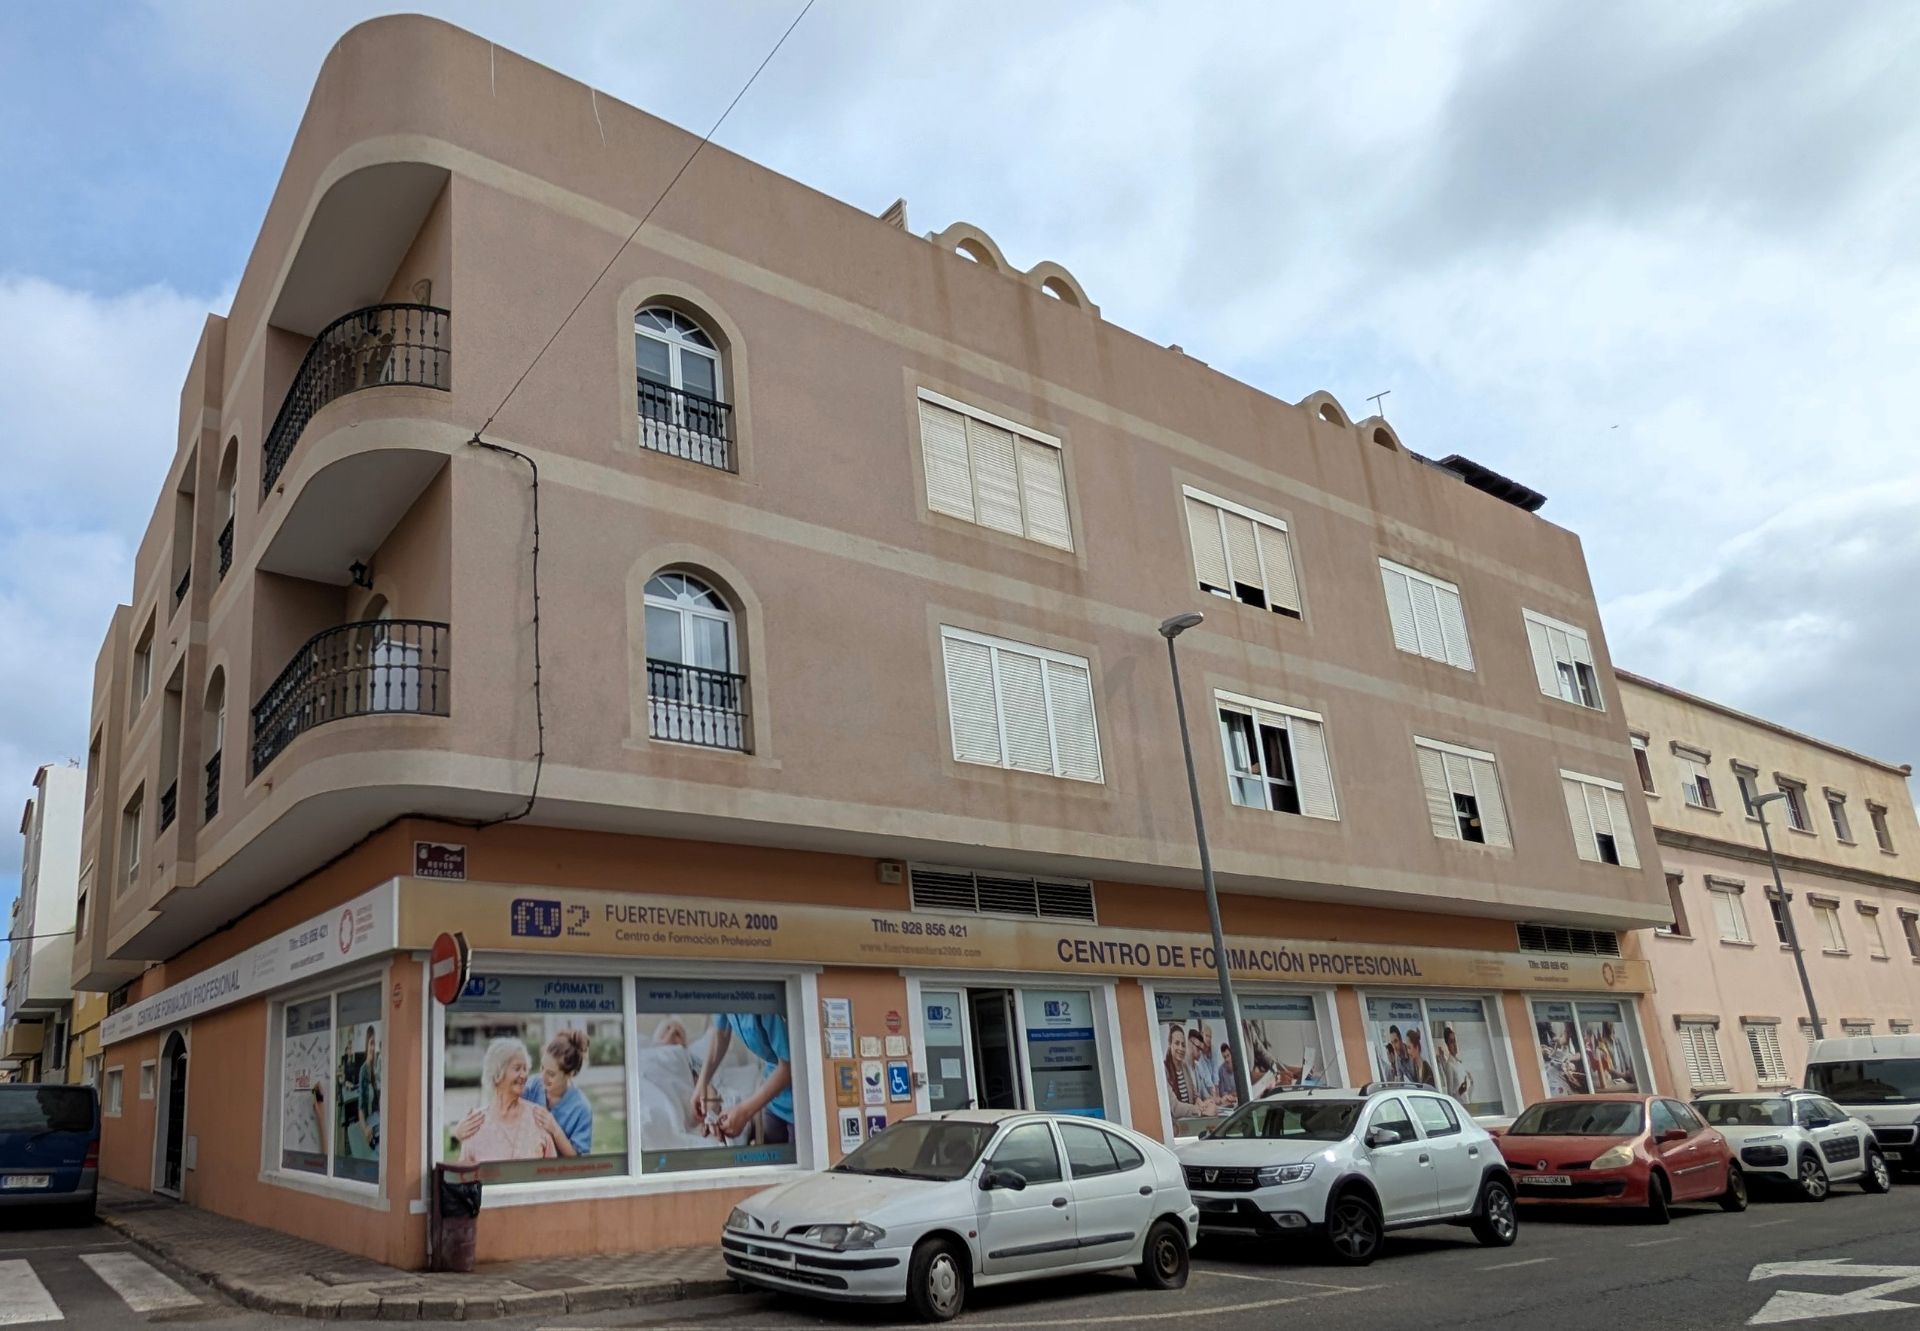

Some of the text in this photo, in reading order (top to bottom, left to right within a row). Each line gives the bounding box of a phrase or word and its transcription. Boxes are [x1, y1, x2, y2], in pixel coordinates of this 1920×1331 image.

[417, 868, 464, 878] CATÓLICOS
[427, 860, 454, 870] REYES
[605, 904, 778, 931] FUERTEVENTURA 2000
[871, 918, 968, 938] Tlfn: 928 856 421
[615, 929, 772, 947] Centro de Formación Profesional
[1057, 938, 1150, 967] CENTRO
[1156, 945, 1186, 968] DE
[1308, 953, 1422, 977] PROFESIONAL
